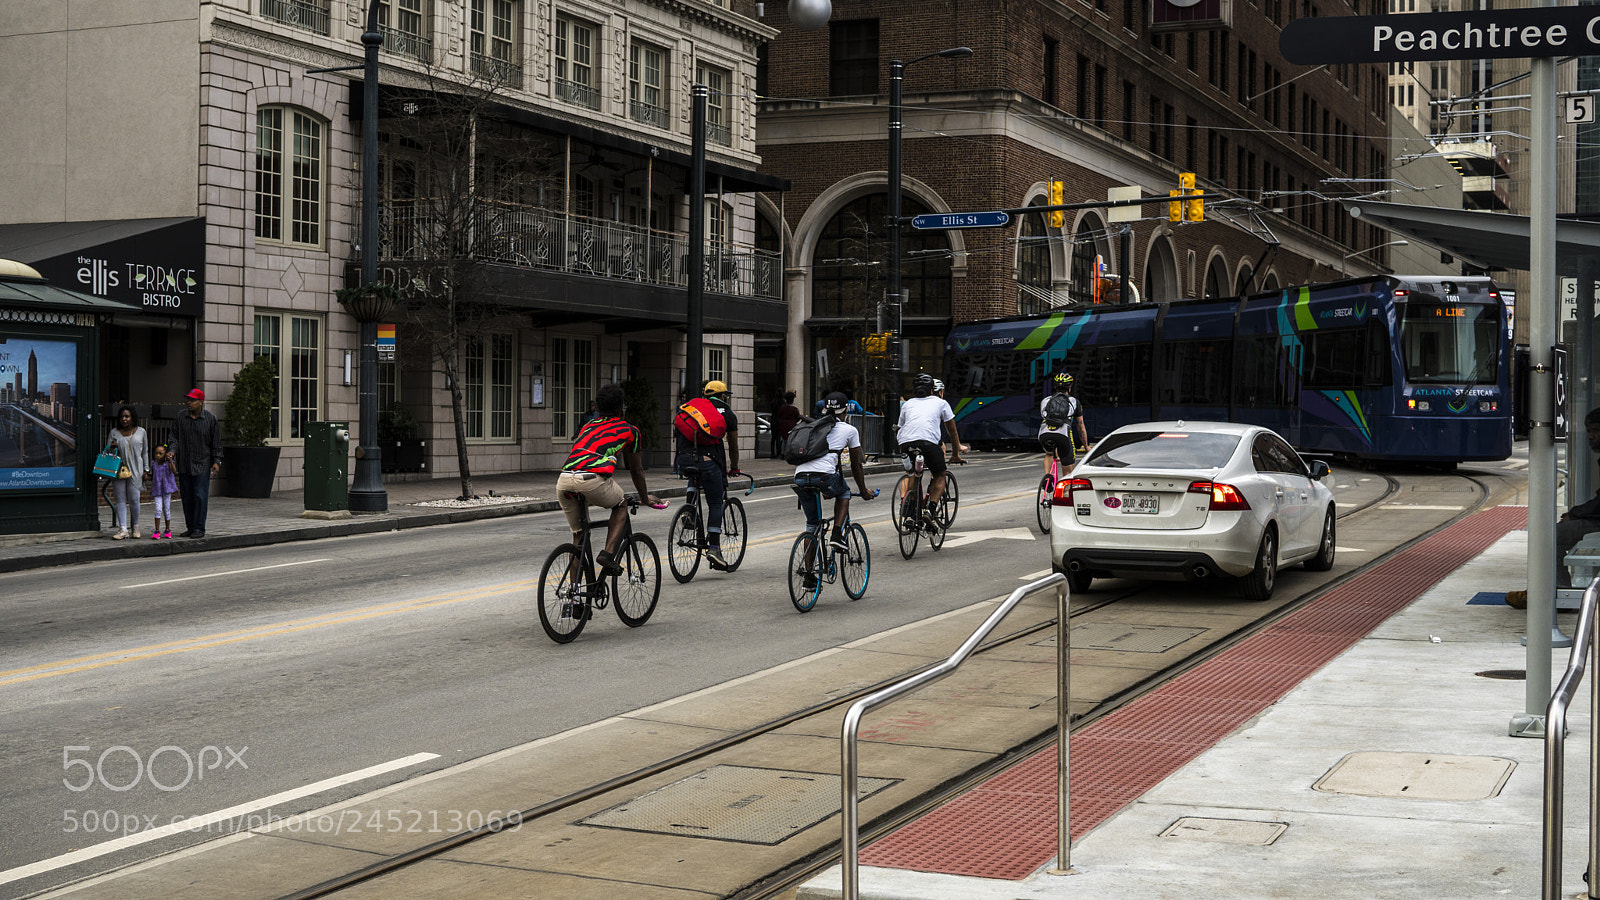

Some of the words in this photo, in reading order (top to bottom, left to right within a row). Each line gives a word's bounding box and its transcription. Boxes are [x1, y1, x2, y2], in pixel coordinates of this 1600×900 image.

[1373, 22, 1568, 52] Peachtree
[1573, 98, 1586, 120] 5
[942, 215, 965, 225] Ellis
[967, 215, 977, 224] St
[77, 256, 91, 265] the
[77, 259, 120, 295] ellis
[125, 263, 196, 295] TERRACE
[143, 292, 181, 308] BISTRO
[1436, 309, 1442, 317] A
[1445, 308, 1466, 317] LINE
[1106, 480, 1175, 488] VOLVO
[1122, 498, 1136, 508] BUR
[1140, 498, 1157, 509] 8930
